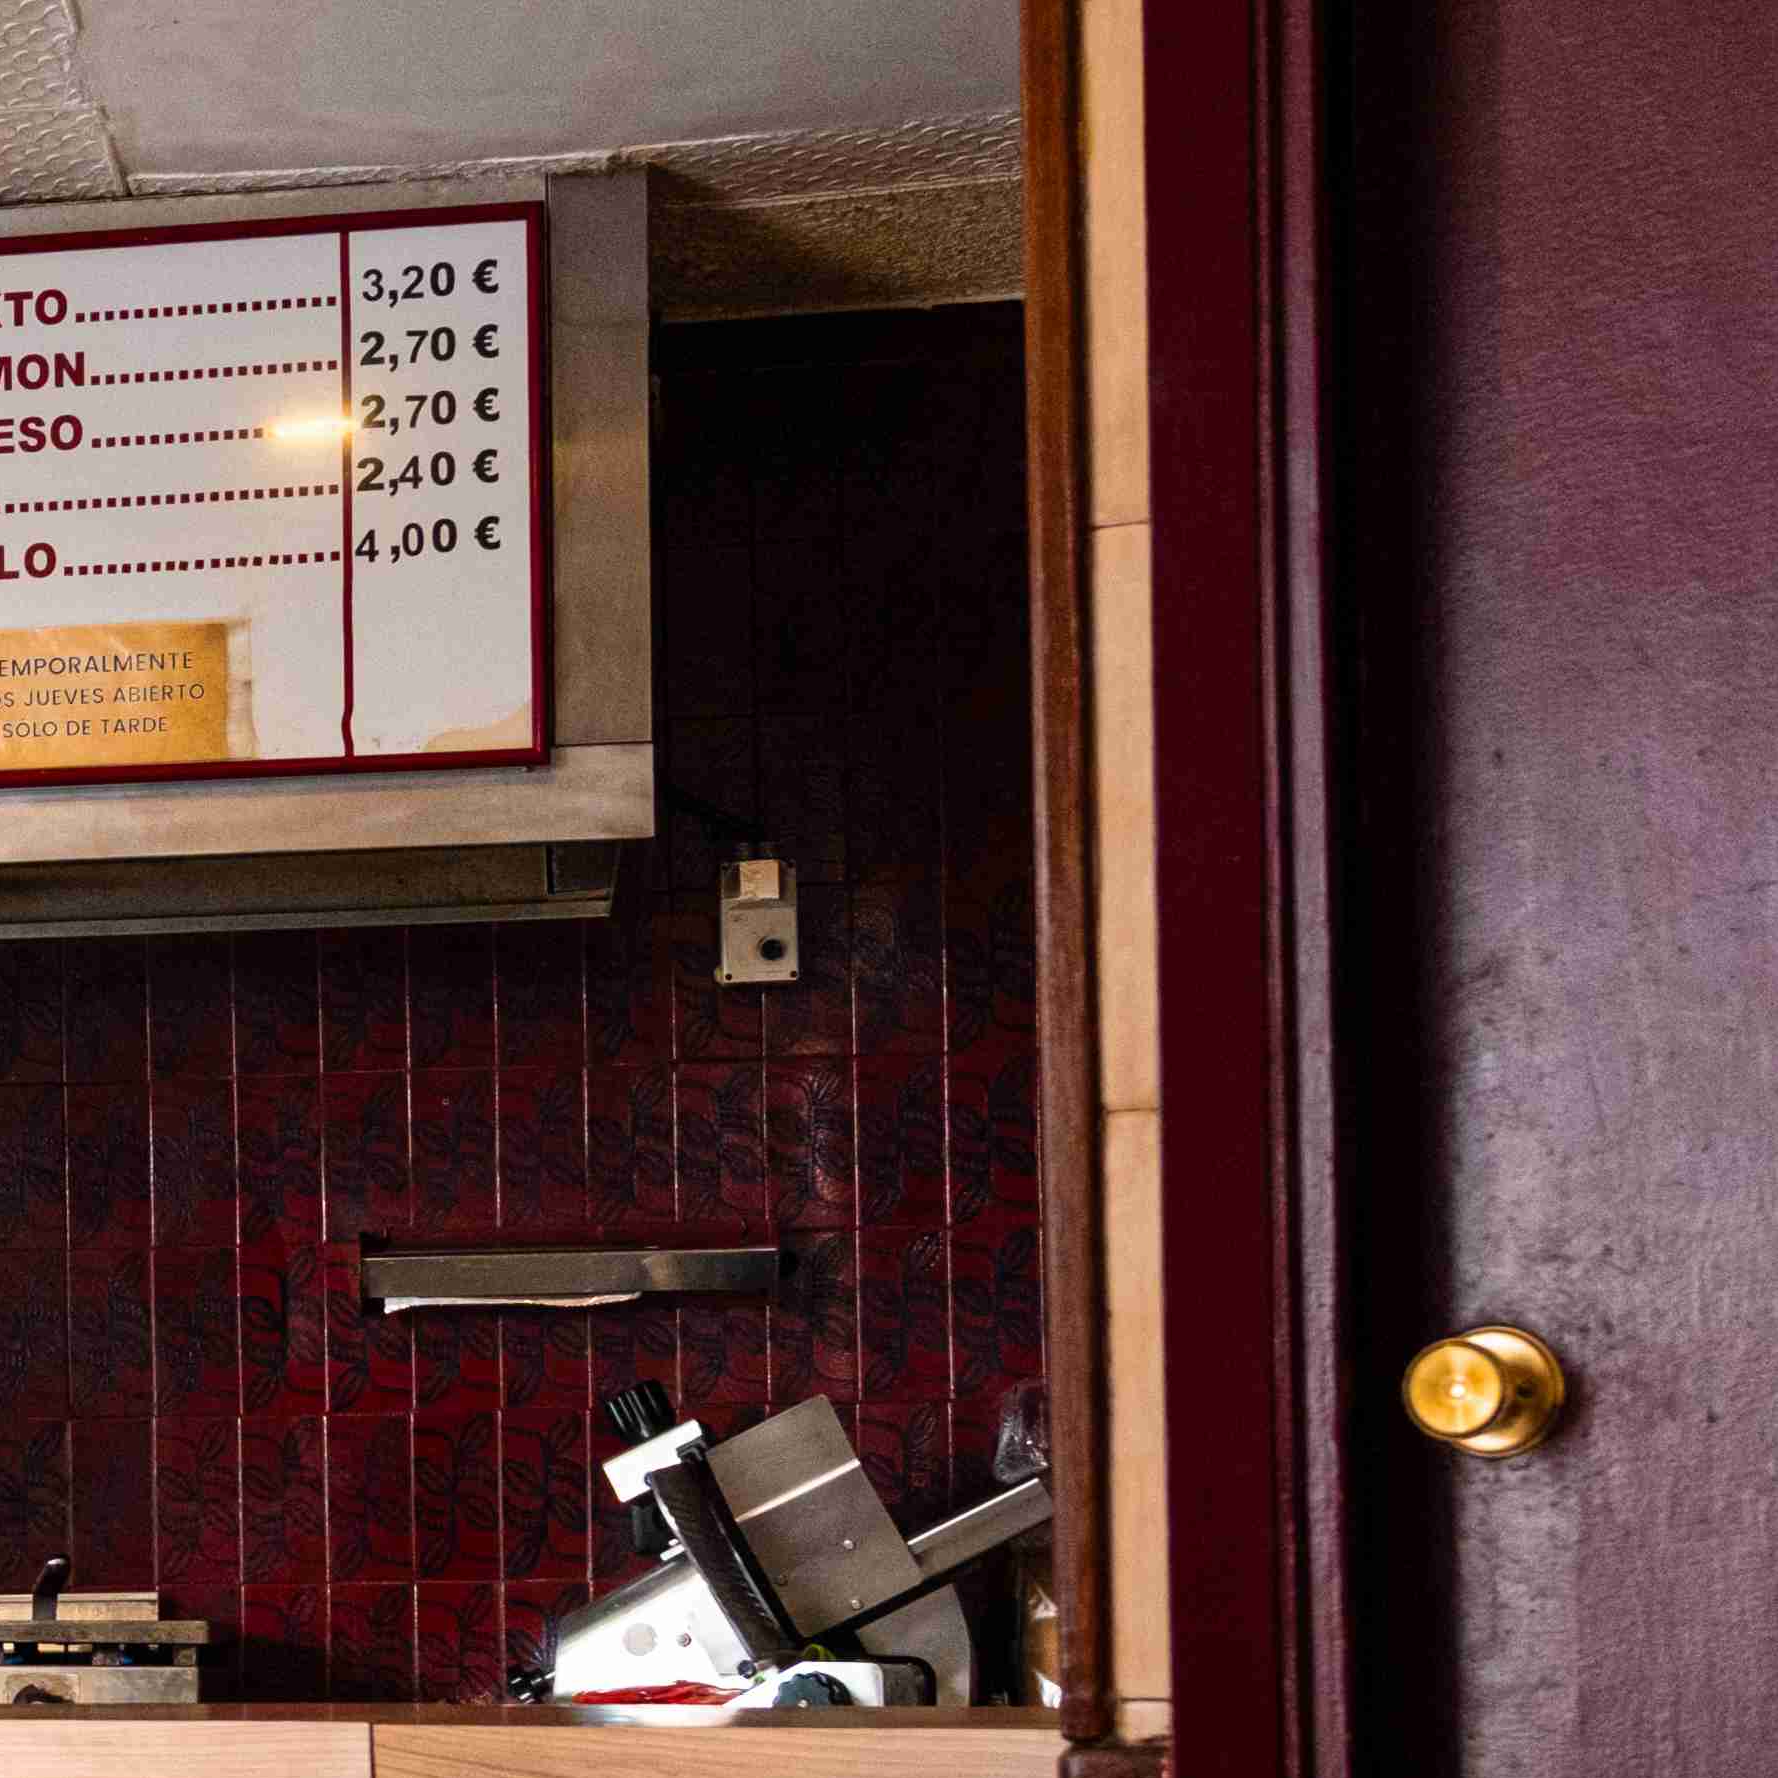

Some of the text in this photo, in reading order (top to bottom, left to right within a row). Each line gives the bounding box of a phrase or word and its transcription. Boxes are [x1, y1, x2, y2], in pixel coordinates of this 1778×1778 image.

[362, 262, 455, 307] 3,20
[472, 259, 499, 293] €
[360, 327, 455, 372] 2,70
[472, 324, 499, 358] €
[362, 391, 456, 435] 2,70
[473, 387, 500, 421] €
[357, 451, 455, 496] 2,40
[472, 449, 499, 482] €
[355, 518, 457, 563] 4,00
[474, 516, 500, 550] €
[24, 687, 104, 707] JUEVES
[113, 683, 205, 704] ABIERTO
[66, 719, 91, 736] DE
[101, 716, 168, 734] TARDE
